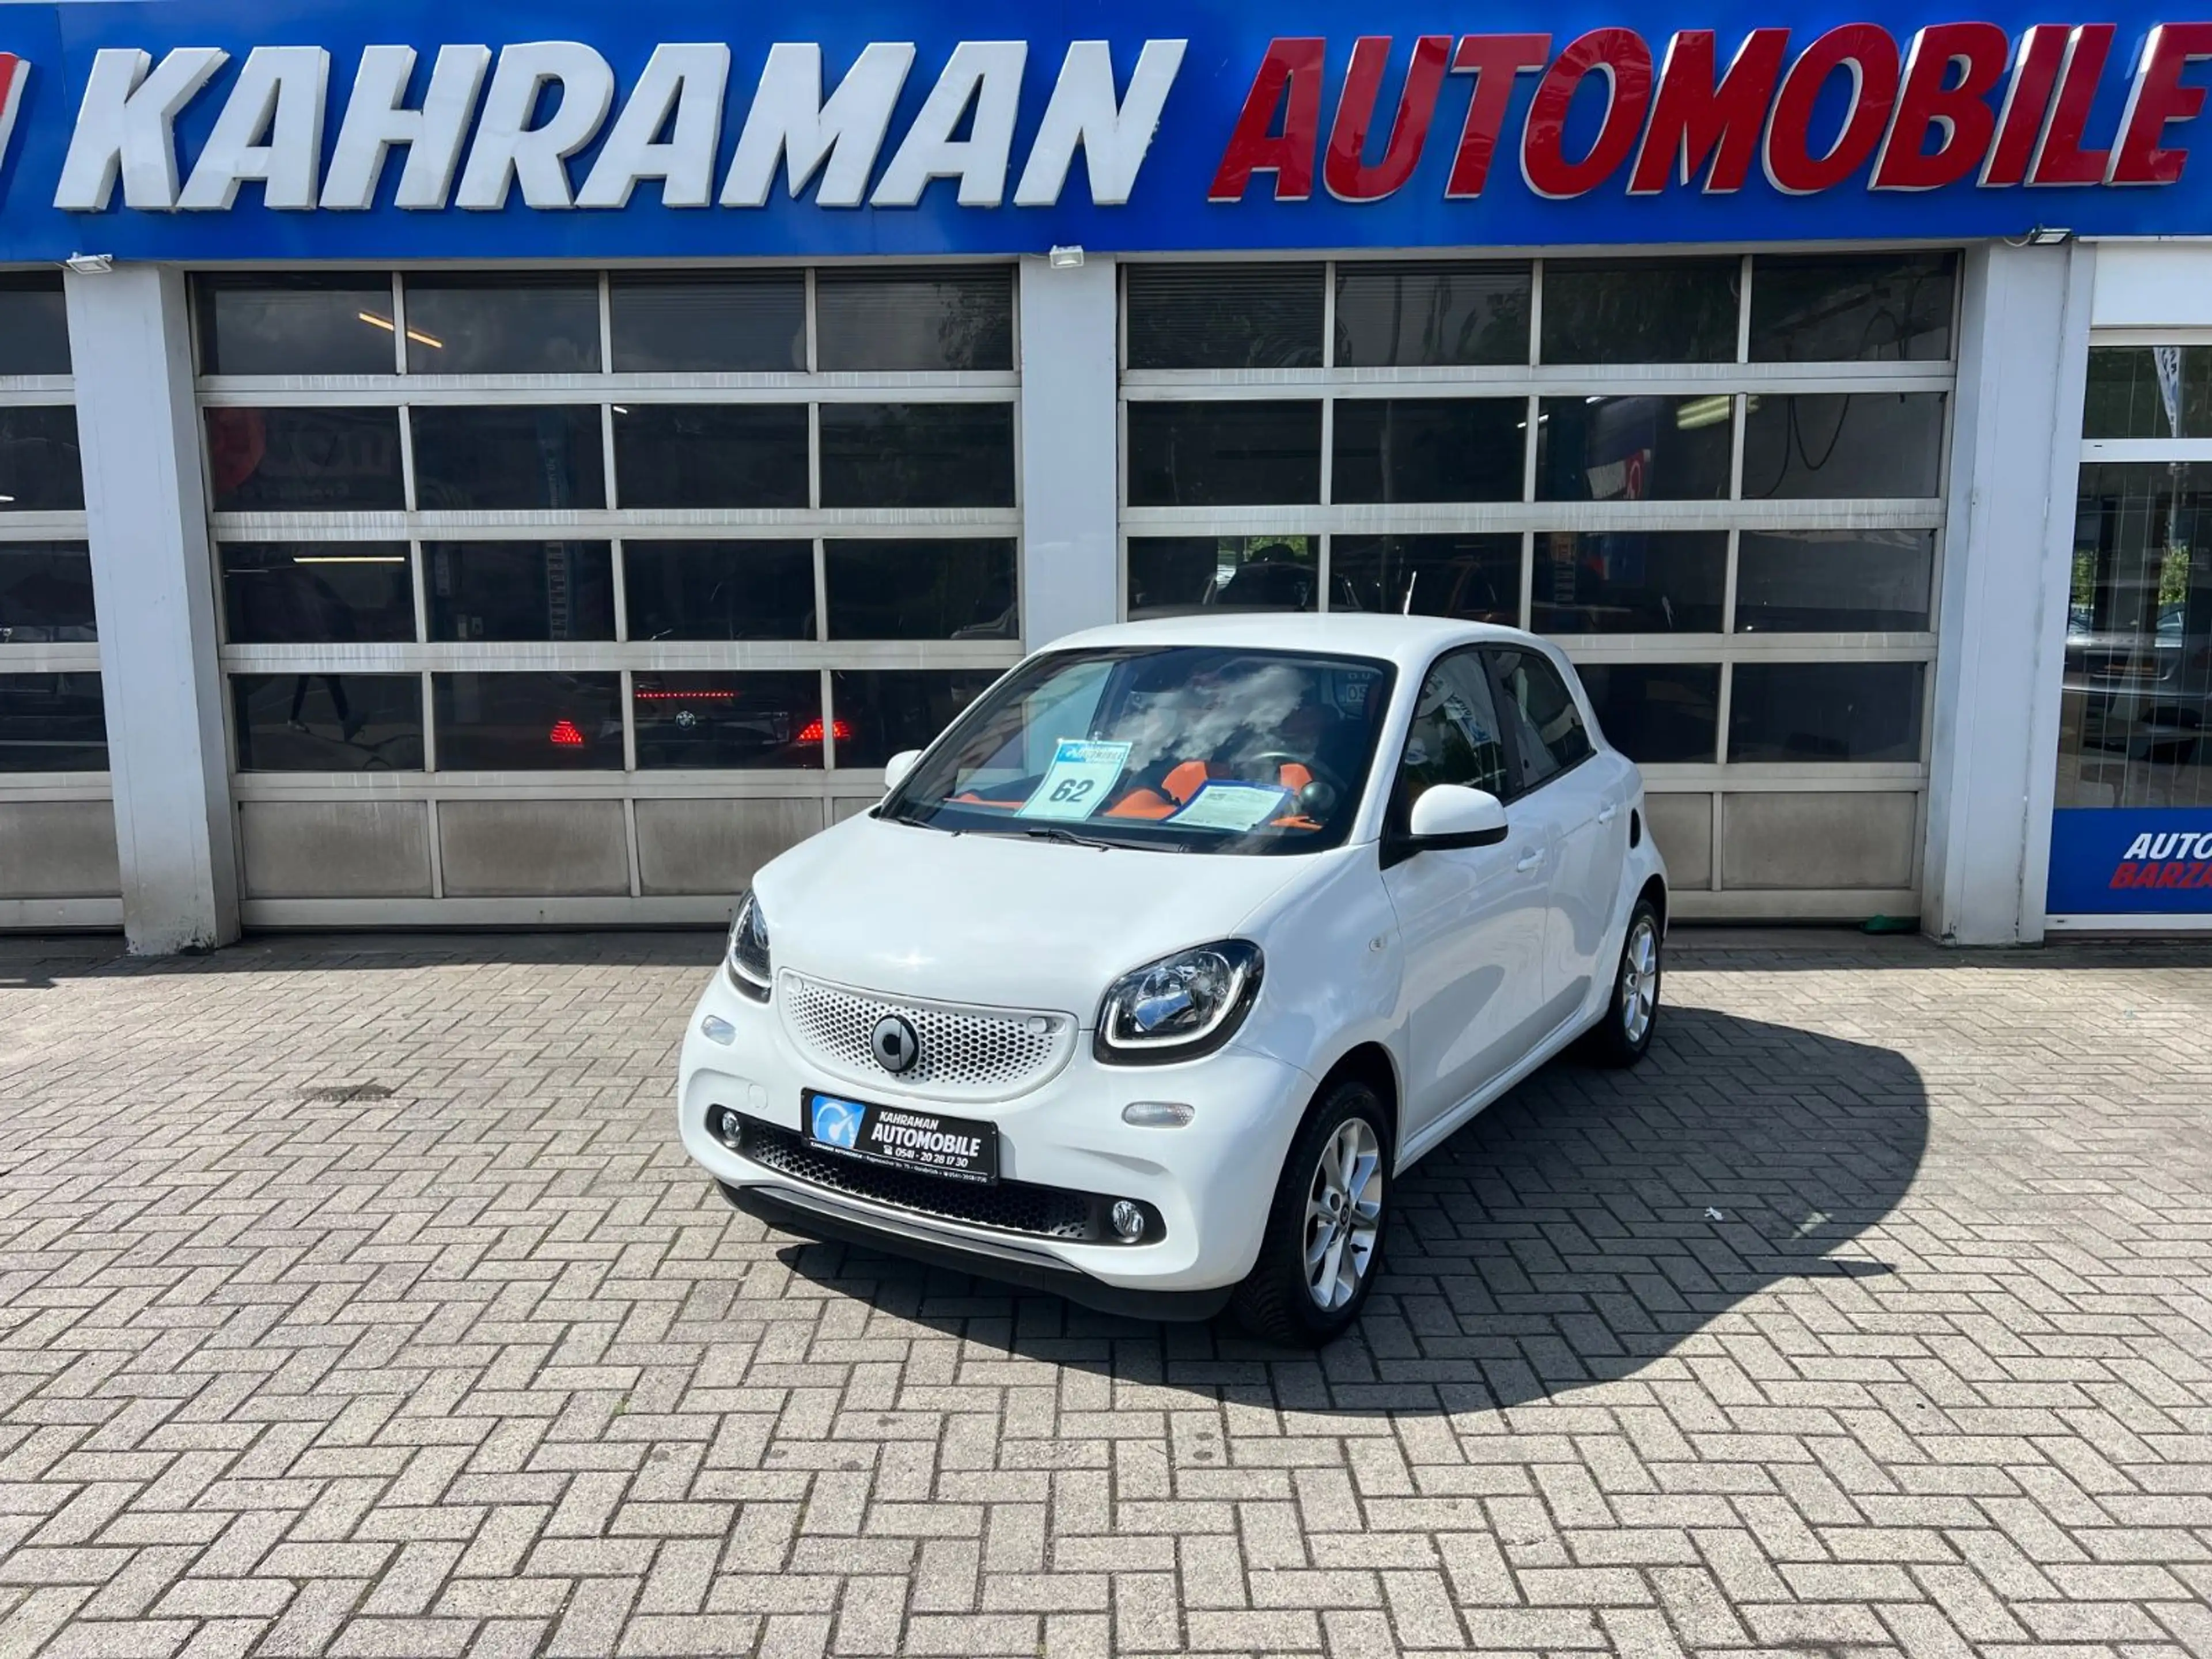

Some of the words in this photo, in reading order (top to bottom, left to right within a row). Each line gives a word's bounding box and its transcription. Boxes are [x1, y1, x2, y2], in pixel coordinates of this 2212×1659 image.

[53, 39, 1188, 212] KAHRAMAN
[1207, 21, 2212, 203] AUTOMOBILE
[1049, 779, 1094, 802] 62
[2123, 833, 2212, 859] AUTO
[879, 1111, 939, 1130] KAHRAMAN
[871, 1123, 981, 1157] AUTOMOBILE
[895, 1147, 915, 1159] 0541
[921, 1152, 933, 1162] 20
[933, 1154, 945, 1164] 28
[946, 1156, 955, 1165] 17
[956, 1157, 968, 1168] 30
